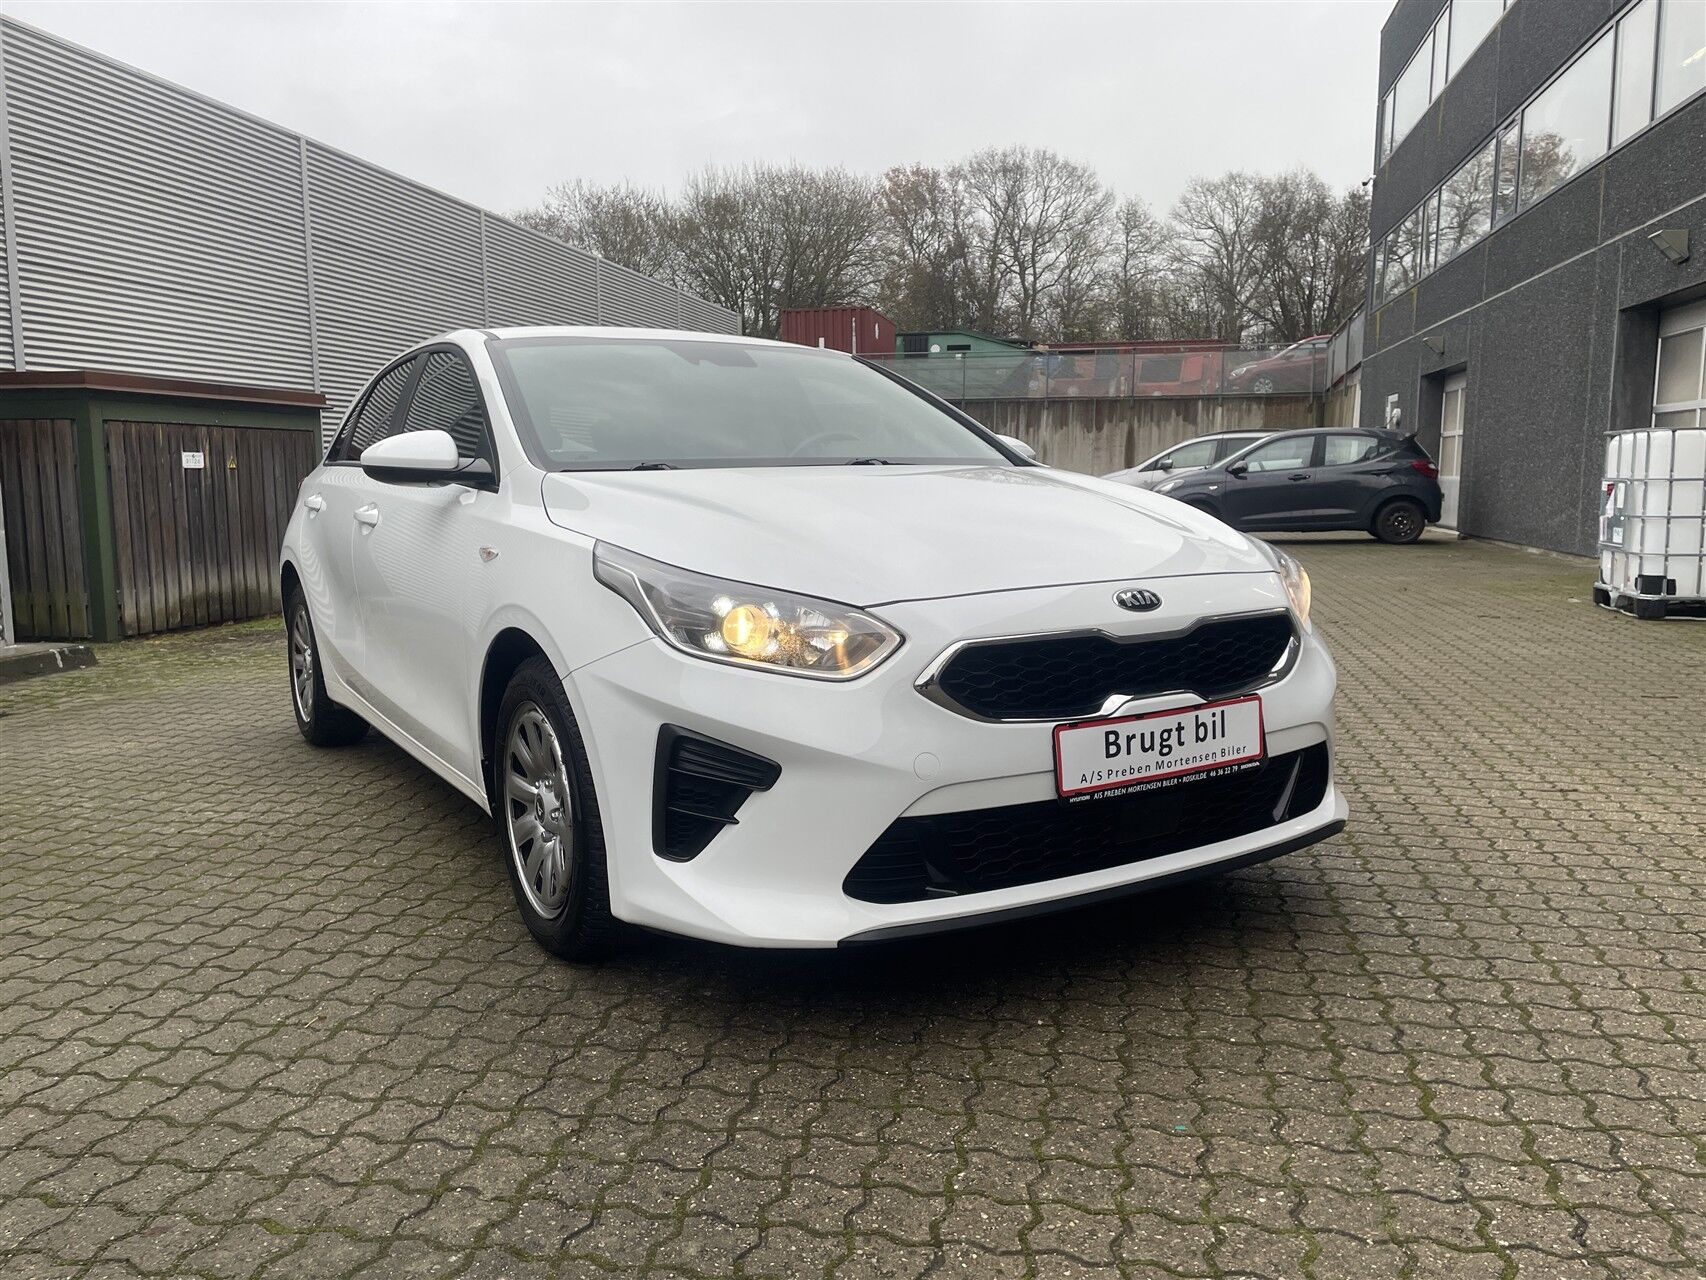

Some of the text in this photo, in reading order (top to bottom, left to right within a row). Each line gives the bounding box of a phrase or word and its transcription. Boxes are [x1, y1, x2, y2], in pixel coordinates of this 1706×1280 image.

[1119, 590, 1159, 607] KIA
[1104, 709, 1226, 759] Brugt bil
[1080, 745, 1247, 785] A/S Preben Mortensen Biler
[1093, 791, 1103, 800] A/S
[1104, 787, 1127, 798] PREBEN
[1127, 781, 1162, 793] MORTENSEN
[1163, 777, 1178, 788] BILER
[1182, 771, 1207, 783] ROSKILDE
[1225, 766, 1231, 774] 22
